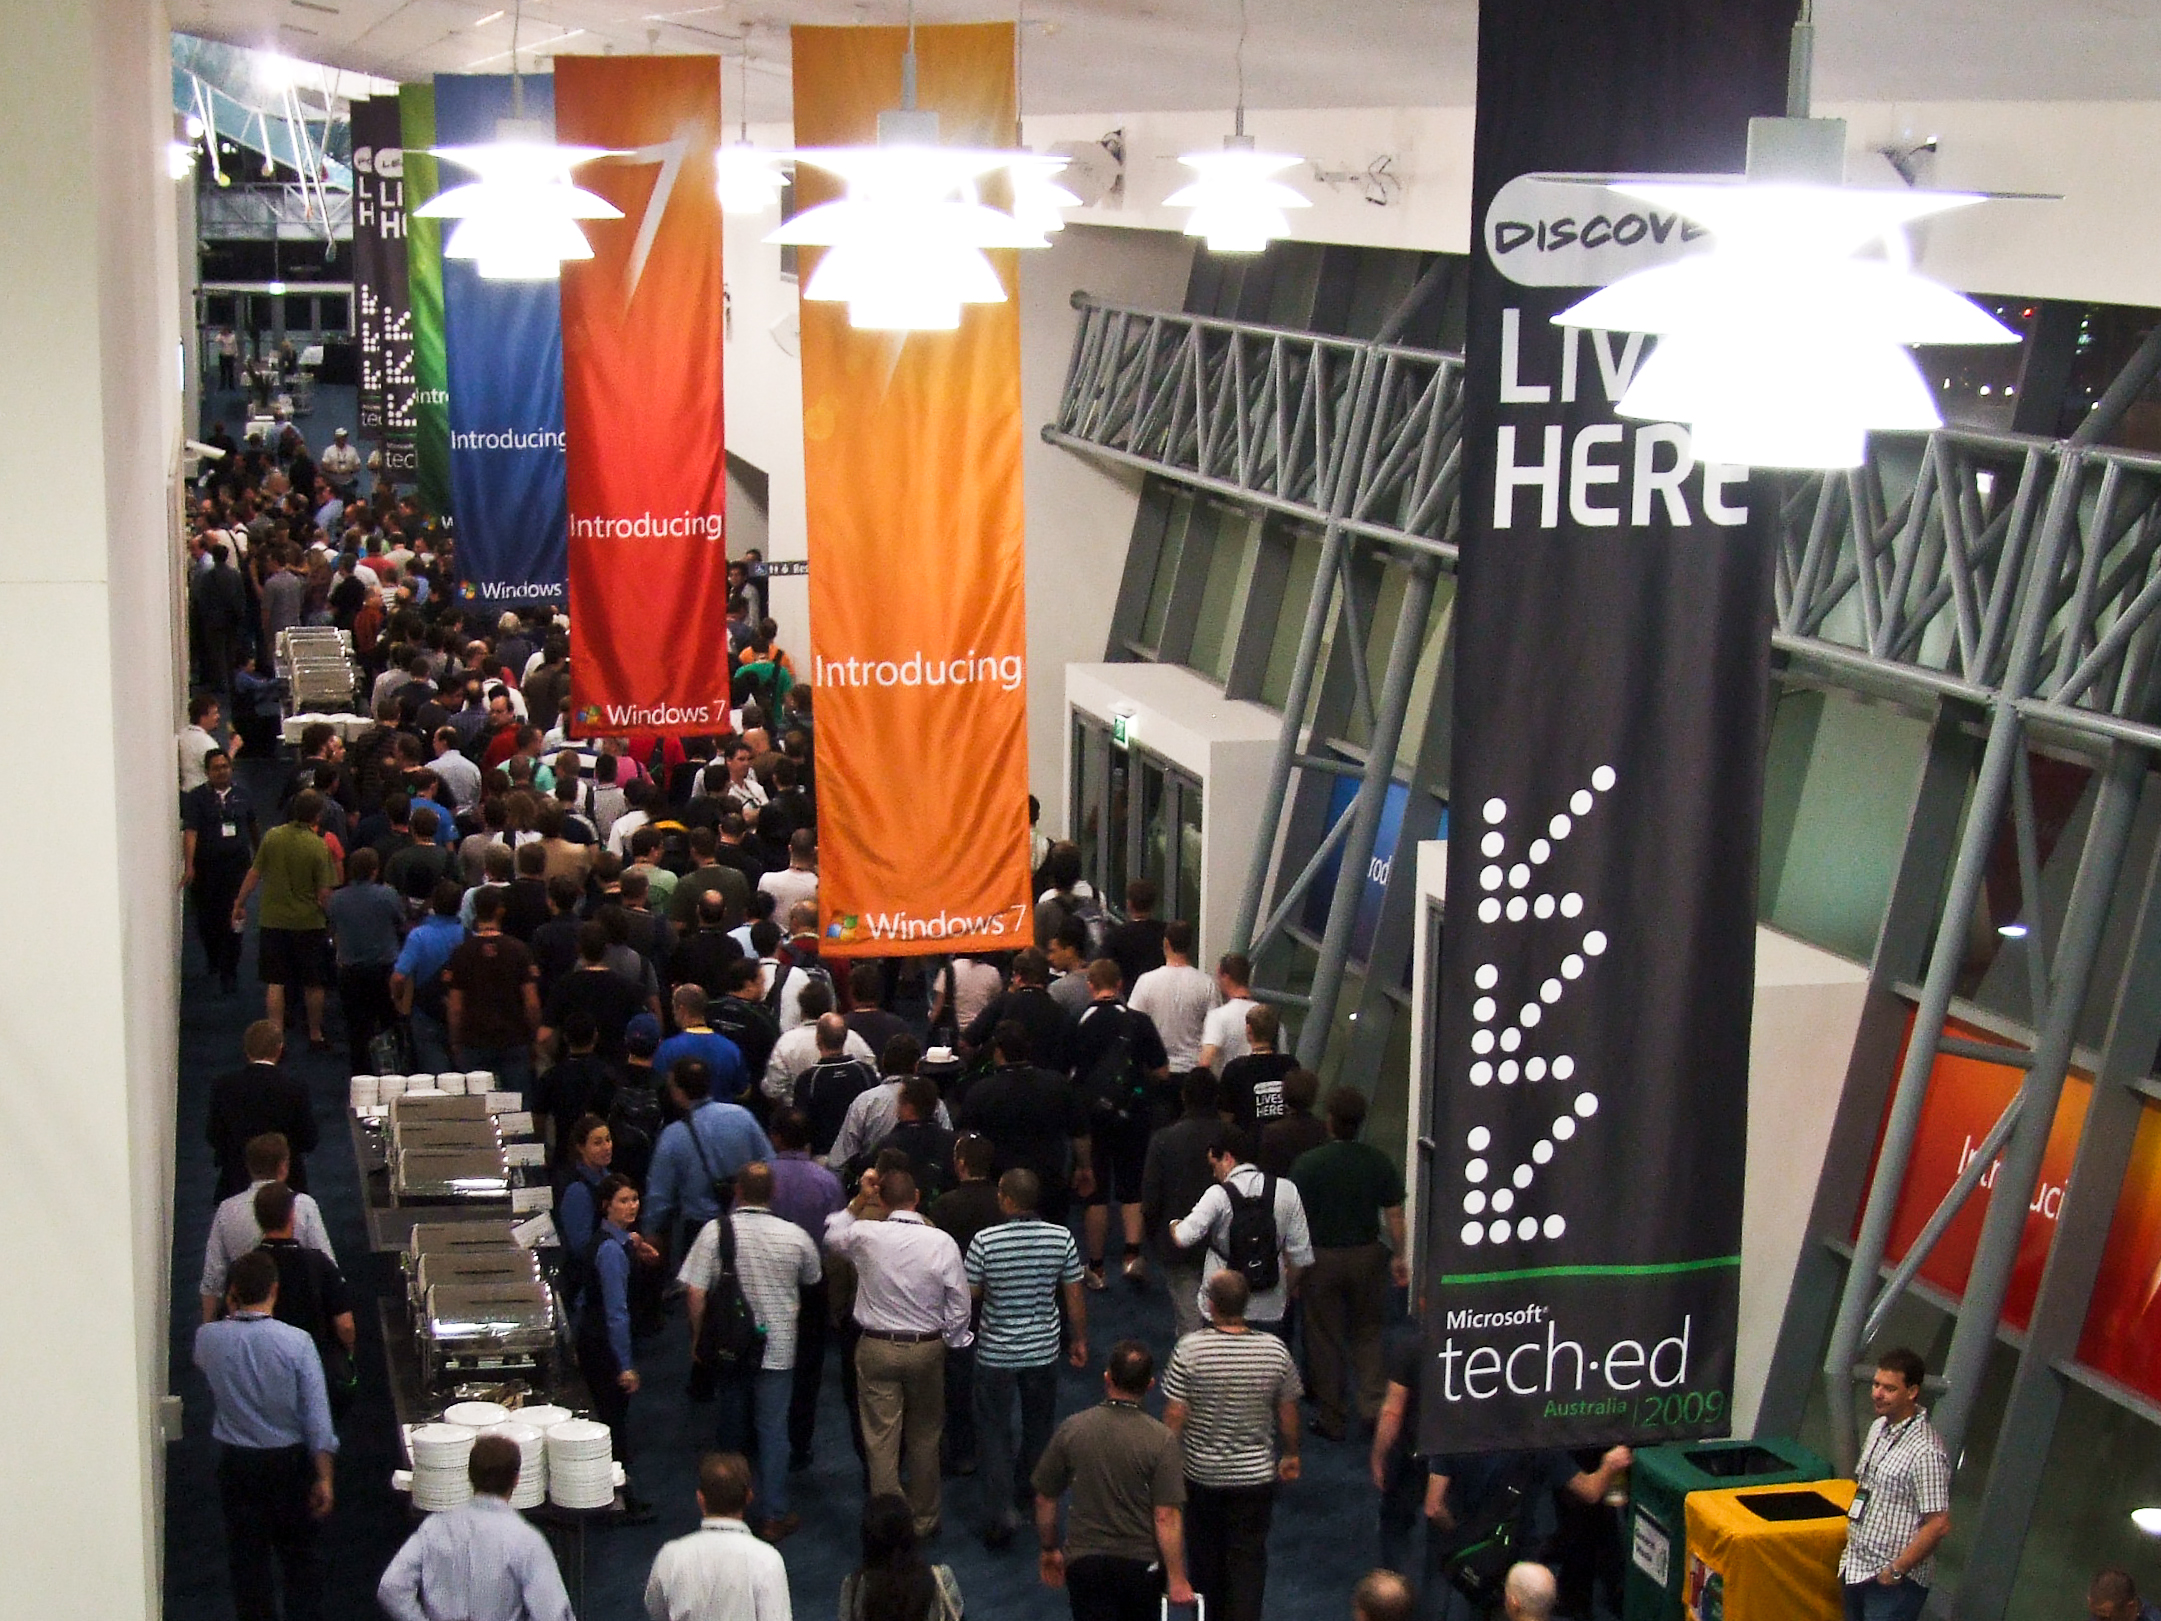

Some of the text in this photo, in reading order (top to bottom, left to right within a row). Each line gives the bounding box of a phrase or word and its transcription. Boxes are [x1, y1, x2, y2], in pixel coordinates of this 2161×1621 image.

[1494, 211, 1714, 255] DISCOVE
[1499, 307, 1648, 404] LIV
[1493, 422, 1750, 530] HERE
[570, 510, 722, 540] Introducing
[481, 581, 563, 600] Windows
[815, 648, 1022, 692] Introducing
[606, 699, 727, 727] Windows 7
[865, 903, 1027, 941] Windows 7
[1256, 1104, 1284, 1118] HERE
[1446, 1303, 1544, 1330] Microsoft
[1543, 1389, 1725, 1428] Australia 2009
